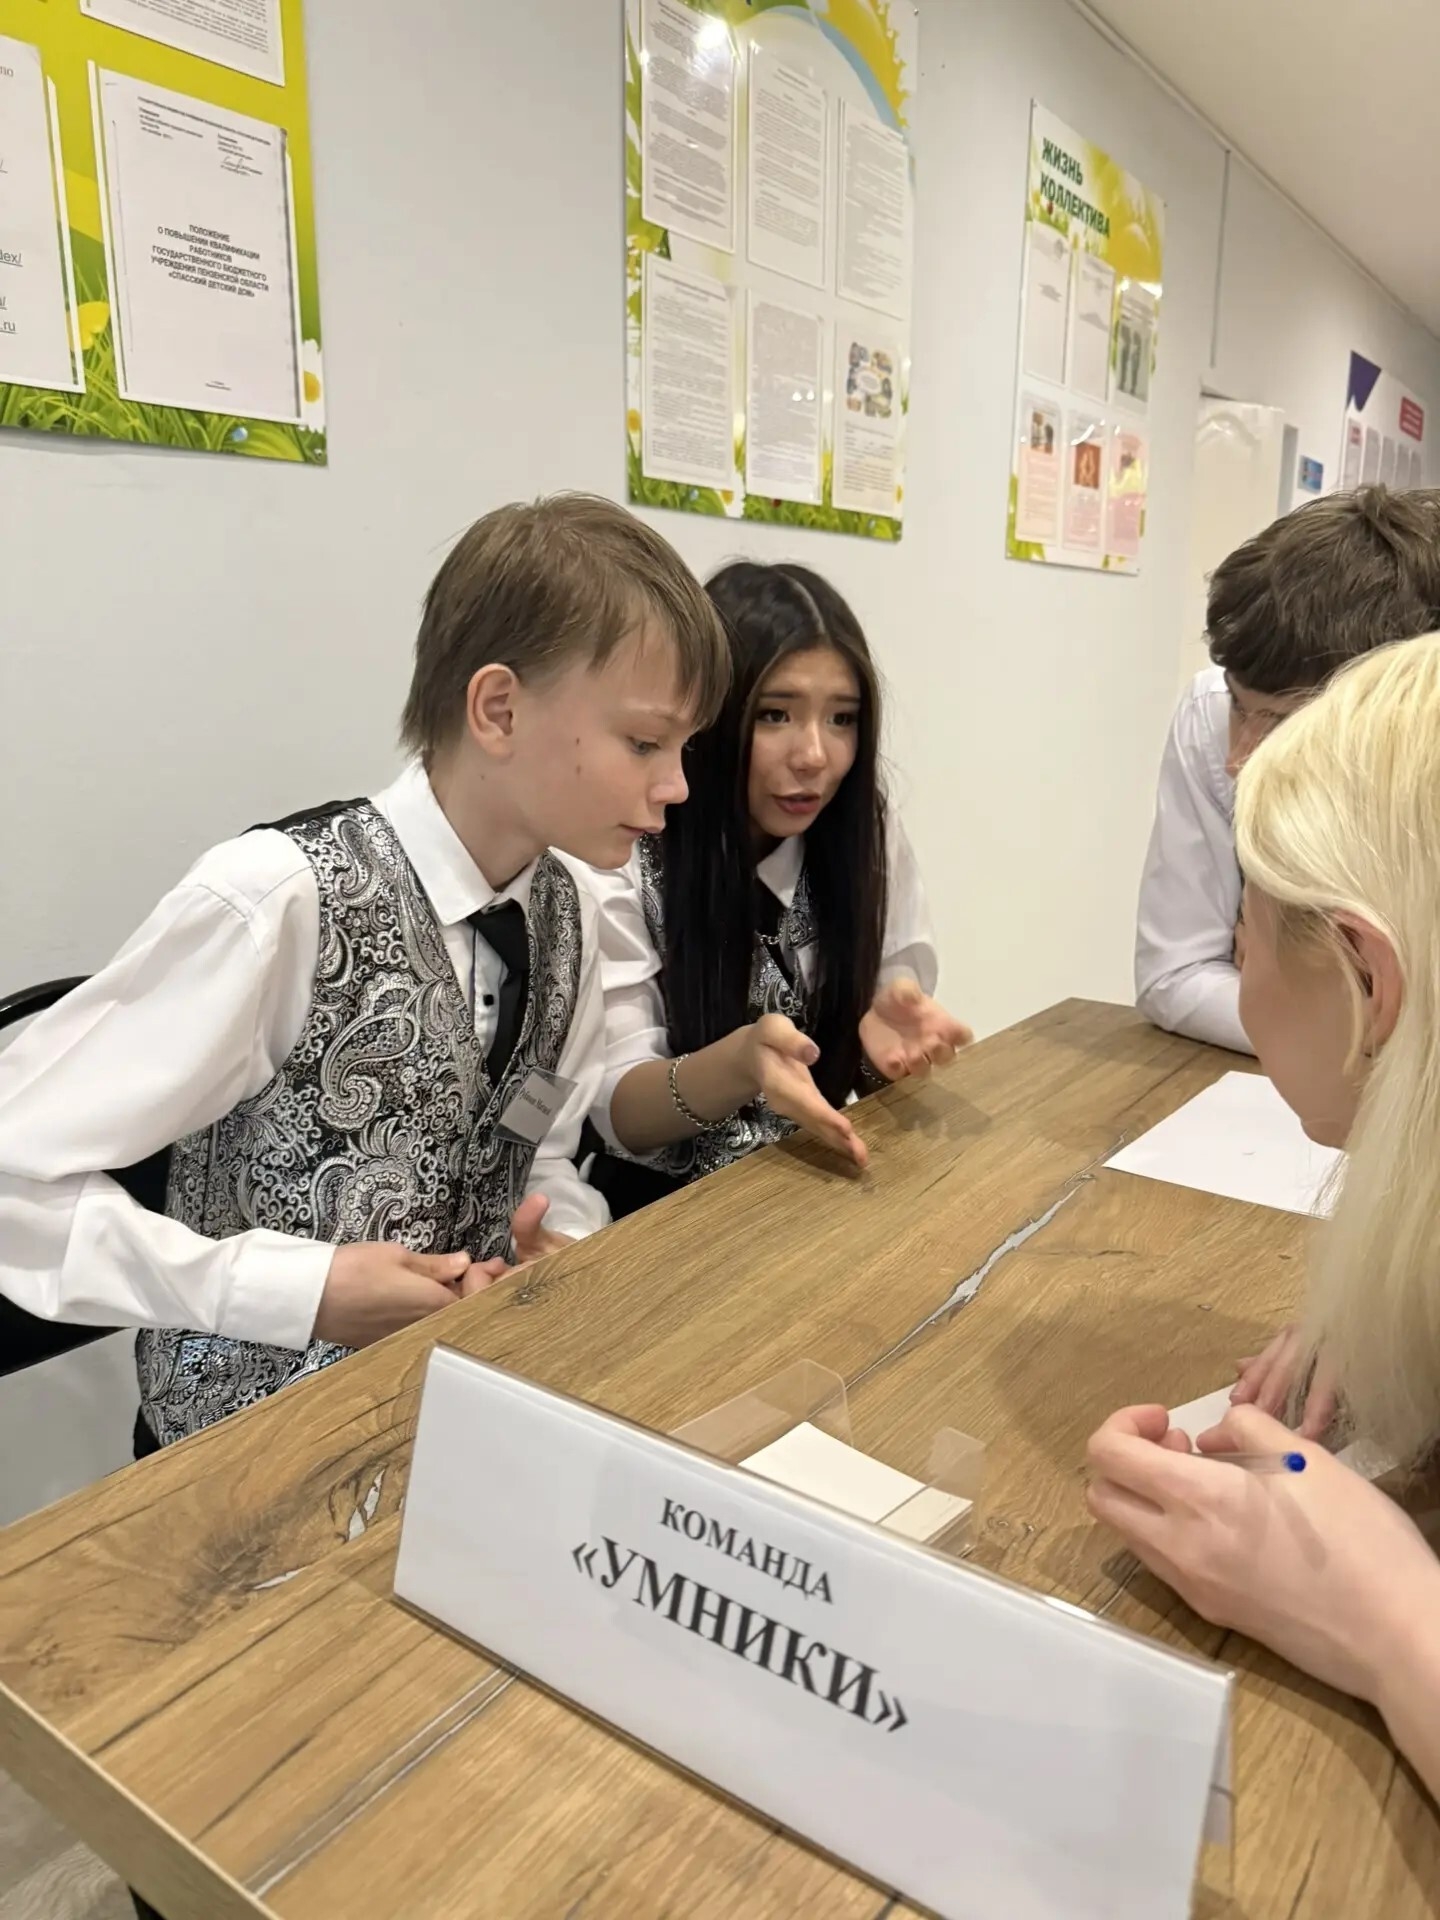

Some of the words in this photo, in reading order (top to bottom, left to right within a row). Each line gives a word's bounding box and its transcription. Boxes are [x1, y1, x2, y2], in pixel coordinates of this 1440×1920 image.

[1042, 137, 1083, 186] ЖИЗНЬ
[1040, 172, 1109, 239] КОЛЛЕКТИВА
[157, 226, 164, 234] О
[164, 227, 209, 246] ПОВЫШЕНИИ
[210, 241, 260, 260] КВАЛИФИКАЦИИ
[189, 224, 230, 242] ПОЛОЖЕНИЕ
[152, 245, 222, 270] ГОСУДАРСТВЕННОГО
[223, 263, 267, 281] БЮДЖЕТНОГО
[189, 245, 232, 262] РАБОТНИКОВ
[151, 255, 197, 272] УЧРЕЖДЕНИЯ
[197, 267, 239, 284] ПЕНЗЕНСКОЙ
[240, 277, 269, 291] ОБЛАСТИ
[168, 271, 207, 286] «СПАССКИЙ
[207, 280, 237, 293] ДЕТСКИЙ
[660, 1497, 833, 1604] КОМАНДА
[572, 1535, 908, 1733] «УМНИКИ»
